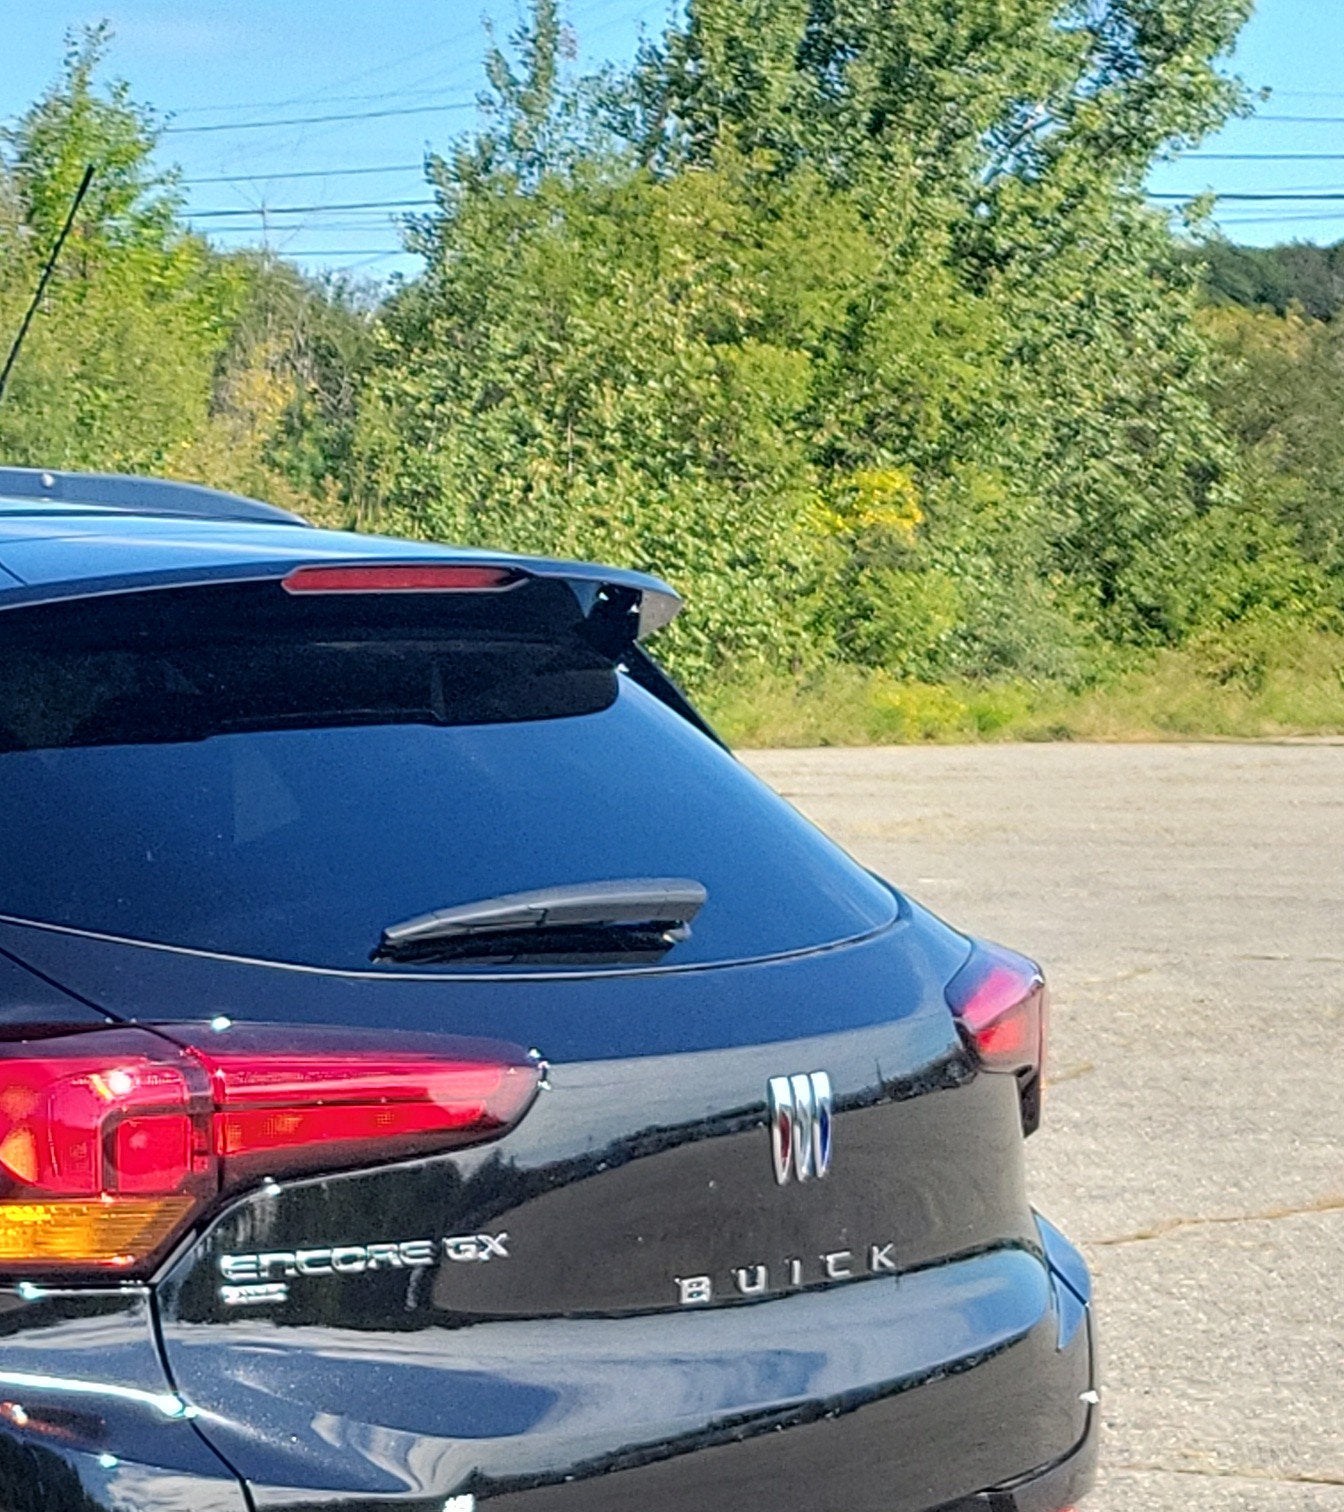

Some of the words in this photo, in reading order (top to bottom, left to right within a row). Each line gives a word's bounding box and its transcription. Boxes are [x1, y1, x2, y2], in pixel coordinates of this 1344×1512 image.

[219, 1240, 436, 1281] ENCORE
[442, 1231, 510, 1263] GX
[675, 1243, 896, 1304] BUICK
